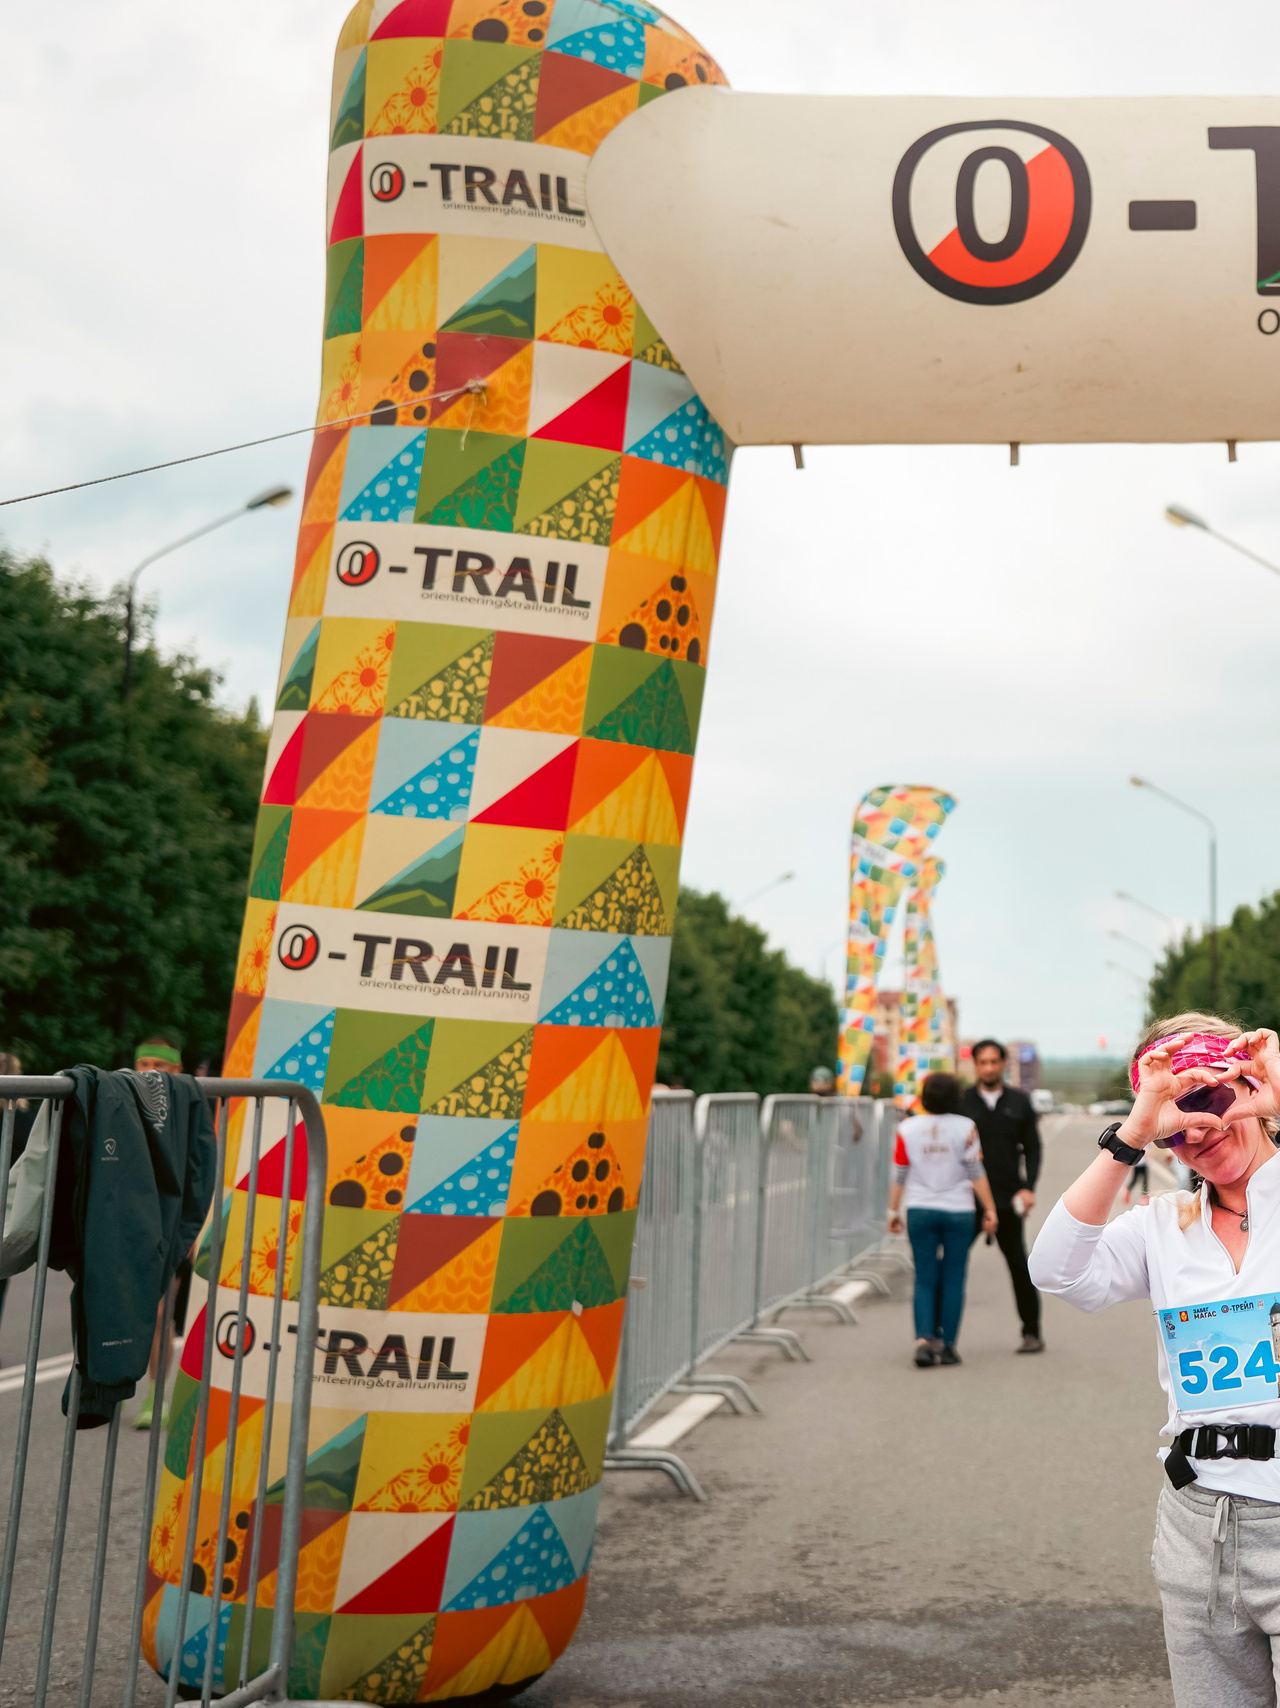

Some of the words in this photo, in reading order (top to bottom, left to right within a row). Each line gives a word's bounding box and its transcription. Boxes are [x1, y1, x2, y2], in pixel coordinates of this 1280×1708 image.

[442, 202, 587, 228] orienteering&trailrunning
[421, 591, 589, 620] orienteering&trailrunning
[359, 978, 531, 1002] orienteering&trailrunning
[1193, 1311, 1217, 1320] МАГАС
[1178, 1339, 1280, 1395] 524
[312, 1374, 467, 1391] enteering&trailrunning
